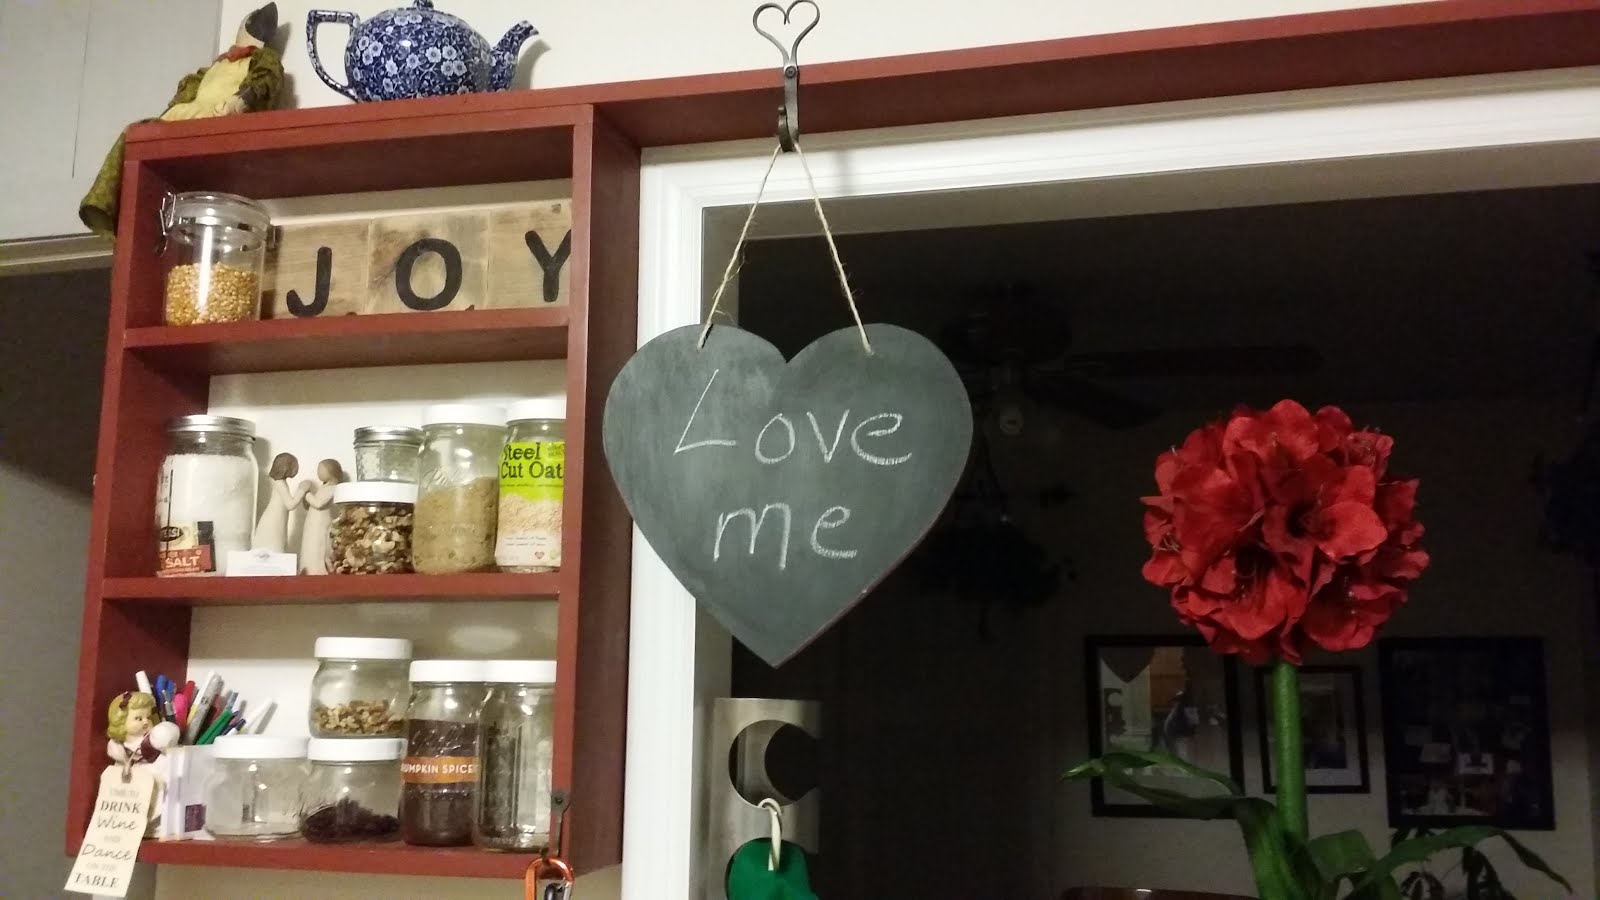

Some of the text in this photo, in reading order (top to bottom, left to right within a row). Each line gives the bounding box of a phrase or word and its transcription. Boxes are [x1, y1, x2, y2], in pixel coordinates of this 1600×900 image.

[673, 369, 912, 465] Love
[502, 441, 542, 461] Steel
[500, 461, 524, 479] Cut
[714, 502, 858, 571] me
[165, 556, 200, 568] SALT
[100, 800, 142, 814] DRINK
[97, 815, 138, 831] Wine
[81, 843, 134, 861] Dance
[74, 872, 120, 889] TABLE
